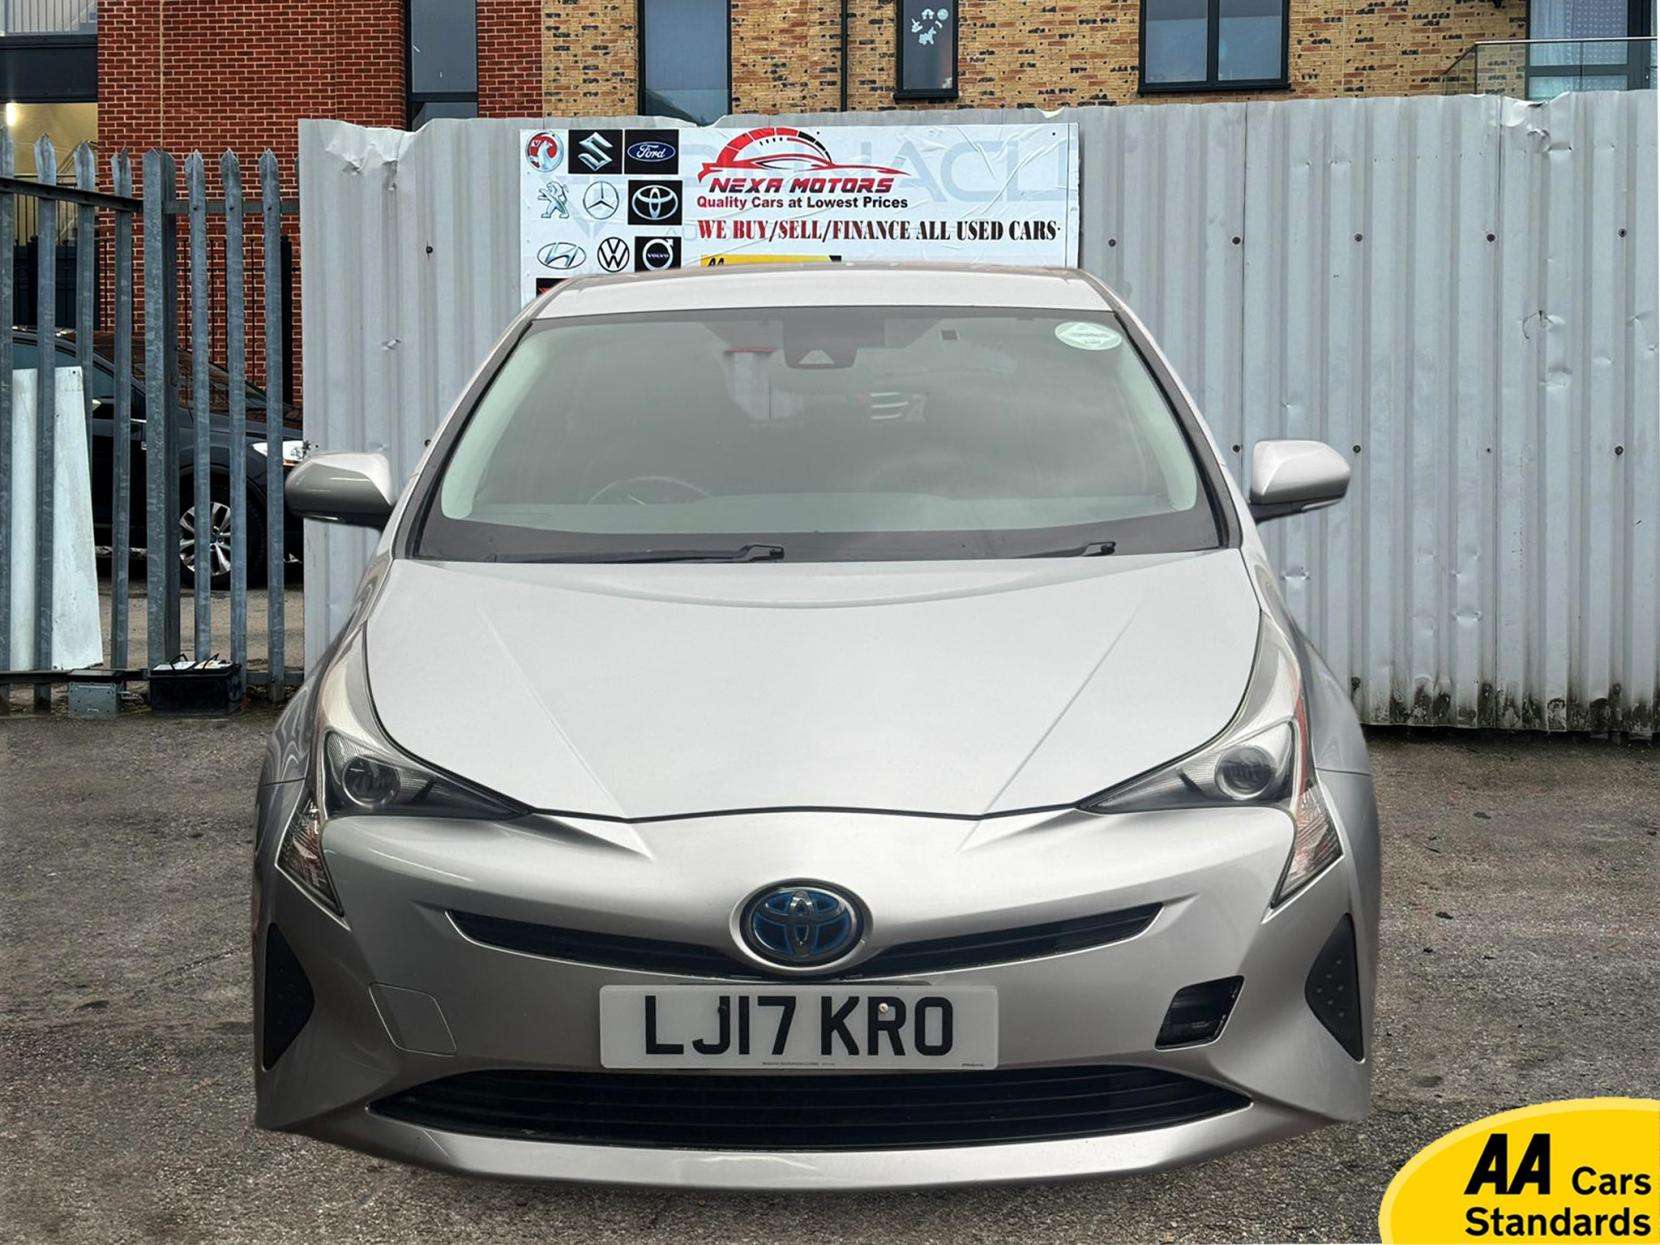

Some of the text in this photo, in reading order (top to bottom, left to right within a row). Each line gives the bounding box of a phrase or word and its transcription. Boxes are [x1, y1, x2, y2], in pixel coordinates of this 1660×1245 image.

[635, 144, 667, 160] Ford
[709, 178, 895, 193] NEXA MOTORS
[697, 193, 909, 210] Quality Cars at Lowest Prices
[698, 220, 727, 239] WE
[733, 219, 911, 243] BUY/SELL/FINANCE
[915, 221, 951, 240] ALL
[956, 221, 1004, 240] USED
[1008, 221, 1057, 240] CARS
[645, 995, 954, 1057] LJ17 KRO
